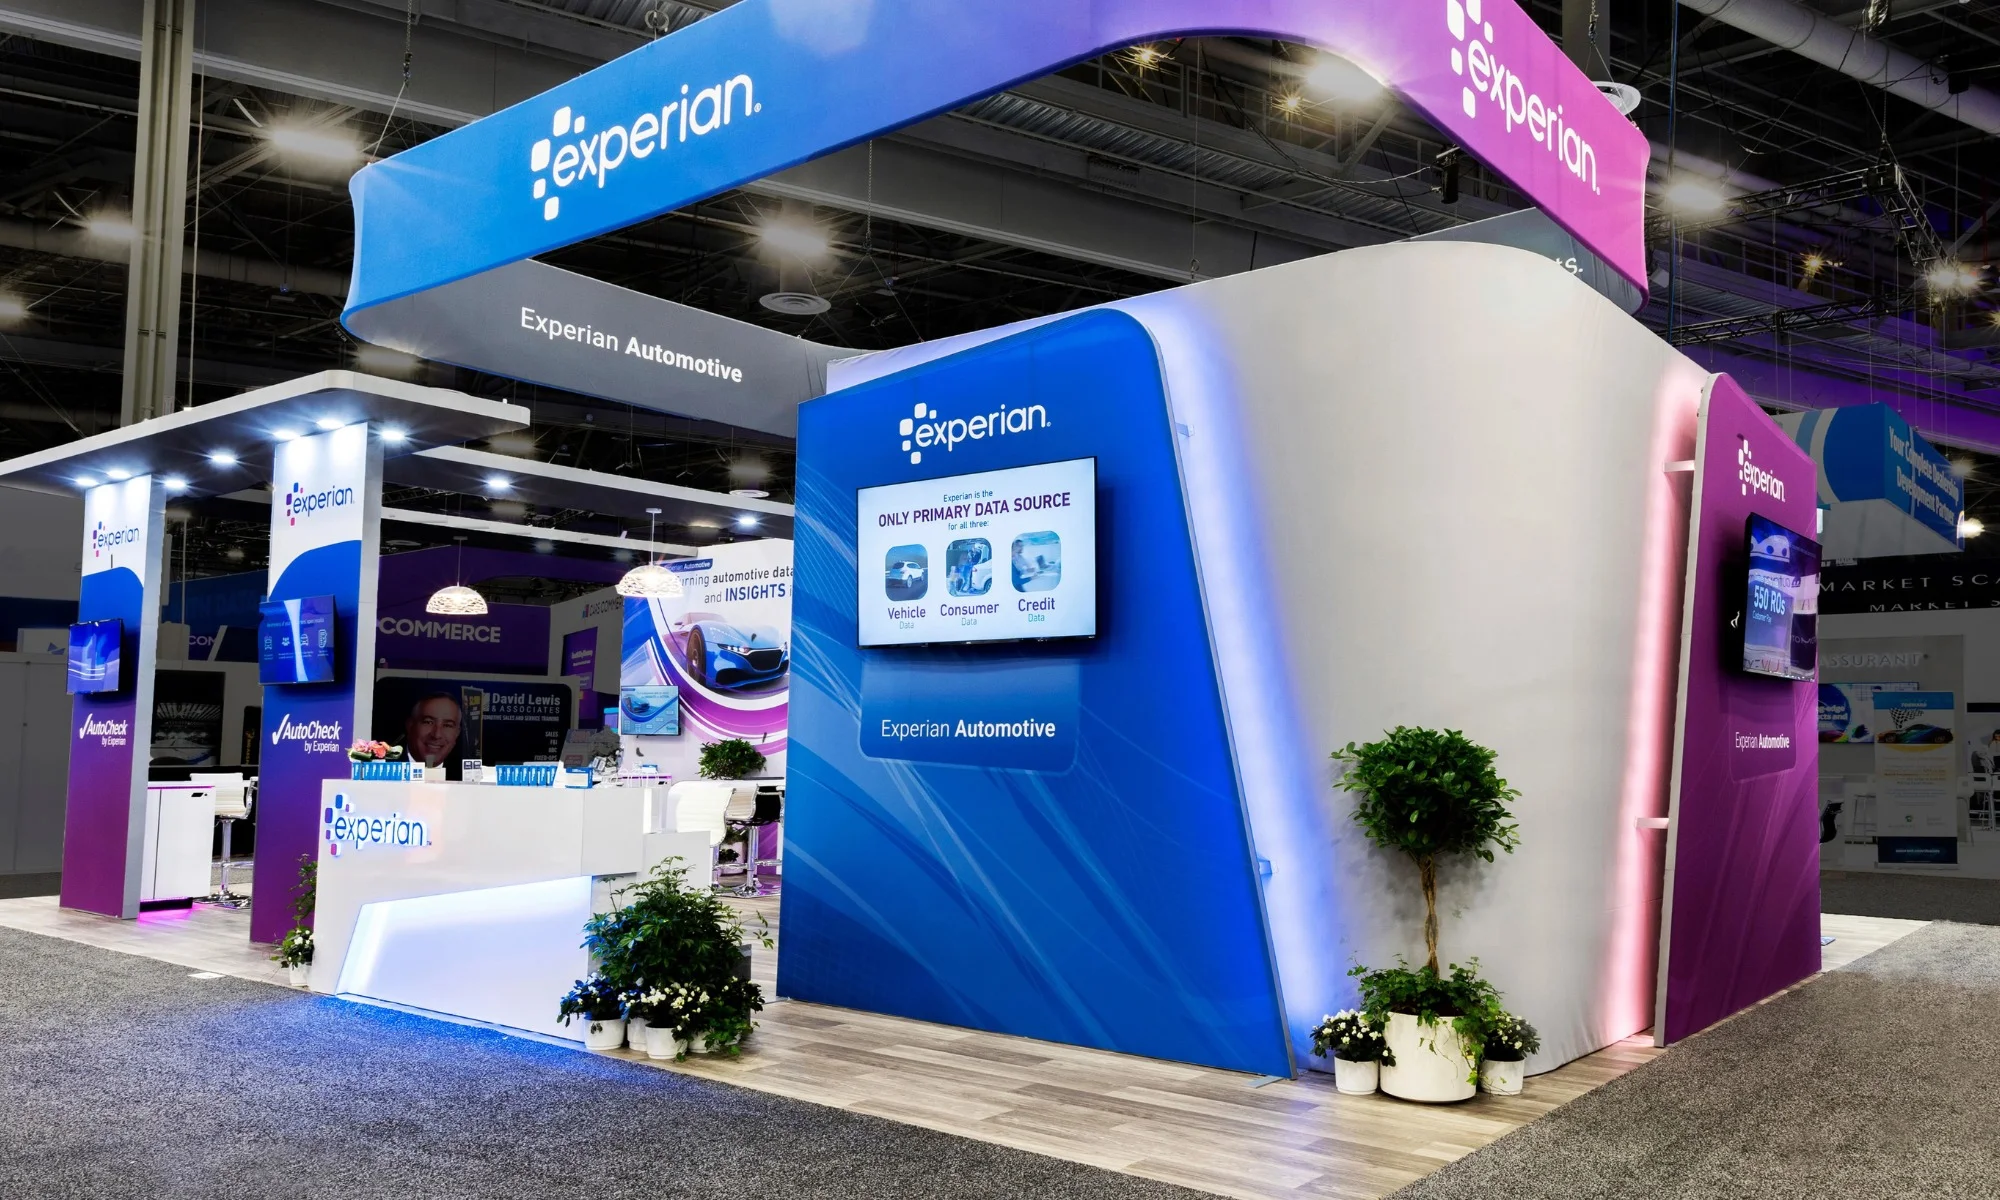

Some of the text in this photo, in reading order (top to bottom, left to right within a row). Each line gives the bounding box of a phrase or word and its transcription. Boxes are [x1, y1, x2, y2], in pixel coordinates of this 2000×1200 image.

[1468, 39, 1597, 192] experian
[552, 74, 753, 188] experian
[521, 306, 743, 383] Experian Automotive
[915, 404, 1047, 452] experian
[1743, 461, 1785, 502] experian
[293, 485, 353, 517] experian
[943, 490, 993, 503] Experian is the
[878, 492, 1071, 527] ONLY PRIMARY DATA SOURCE
[948, 522, 958, 530] for
[959, 521, 968, 529] all
[98, 525, 140, 551] experian
[677, 573, 709, 587] urning
[712, 568, 769, 583] automotive
[1819, 576, 1932, 592] MARKET
[704, 591, 722, 603] and
[725, 583, 786, 602] INSIGHTS
[1753, 585, 1786, 615] 550 ROs
[887, 606, 926, 620] Vehicle
[940, 603, 1000, 617] Consumer
[1018, 597, 1056, 612] Credit
[899, 621, 915, 630] Data
[961, 618, 978, 626] Data
[1028, 613, 1045, 622] Data
[380, 617, 501, 643] COMMERCE
[492, 693, 560, 706] David Lewis
[500, 705, 560, 714] ASSOCIATES
[86, 719, 128, 735] AutoCheck
[282, 720, 341, 740] AutoCheck
[881, 718, 1056, 741] Experian Automotive
[102, 736, 126, 747] by Experian
[304, 740, 339, 754] by Experian
[1735, 731, 1790, 752] Experian Automotive
[334, 813, 426, 849] experian
